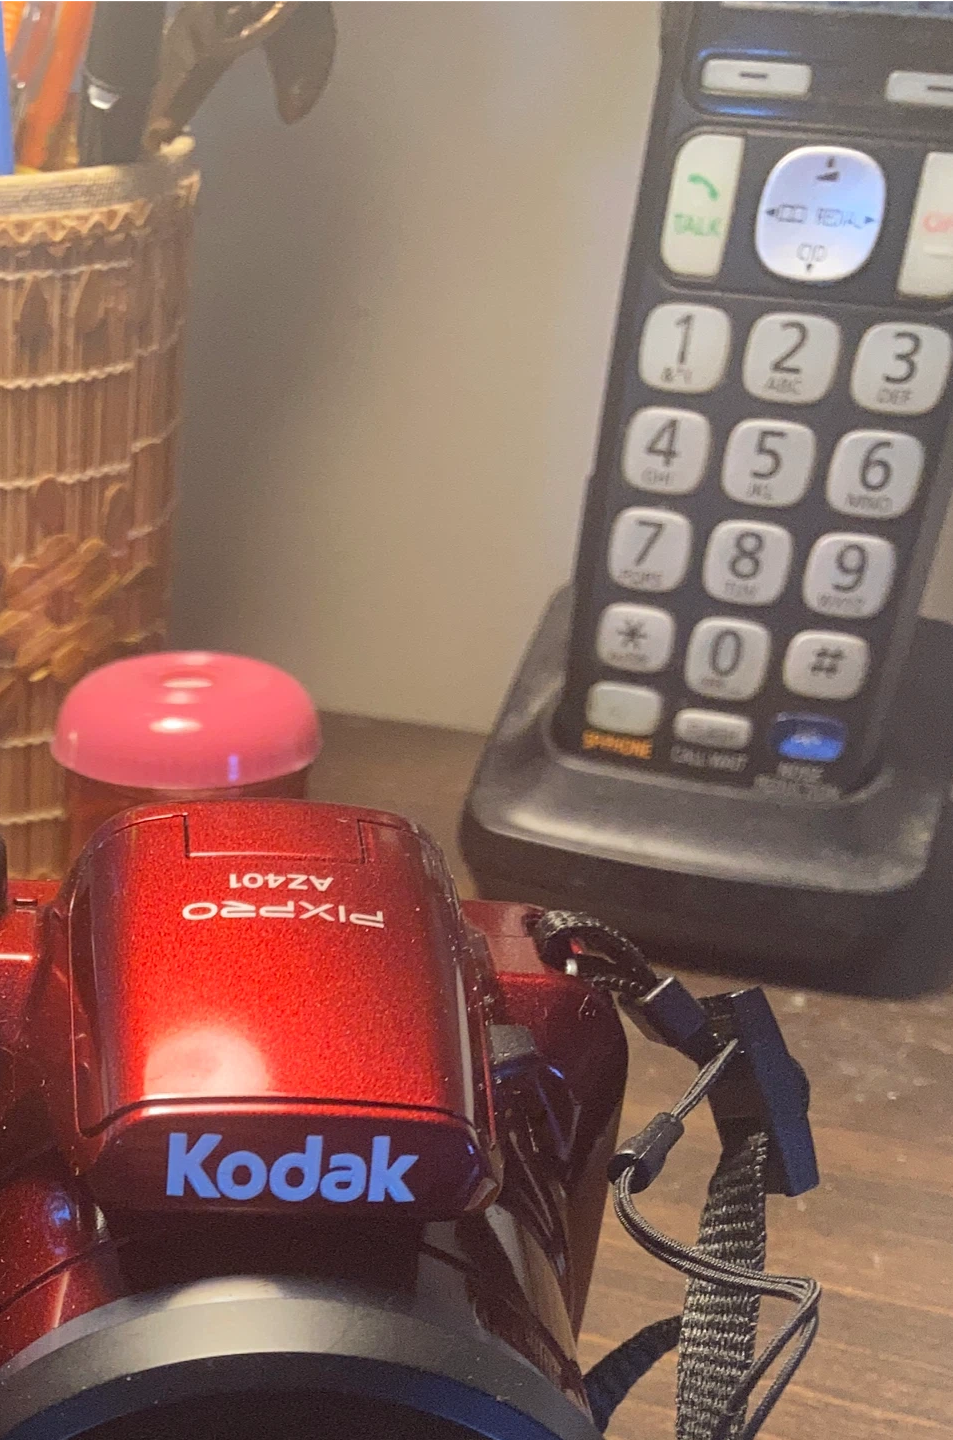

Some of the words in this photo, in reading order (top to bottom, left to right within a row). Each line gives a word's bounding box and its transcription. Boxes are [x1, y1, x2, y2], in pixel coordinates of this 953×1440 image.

[674, 212, 722, 238] TALK
[675, 313, 695, 364] 1
[771, 319, 808, 374] 2
[882, 330, 921, 384] 3
[644, 418, 681, 467] 4
[751, 430, 787, 479] 5
[859, 440, 894, 492] 6
[635, 519, 665, 567] 7
[728, 531, 764, 580] 8
[831, 543, 869, 593] 9
[710, 629, 743, 677] 0
[228, 872, 334, 892] AZ401
[182, 900, 385, 929] PIXPRO
[165, 1131, 420, 1203] Kodak
